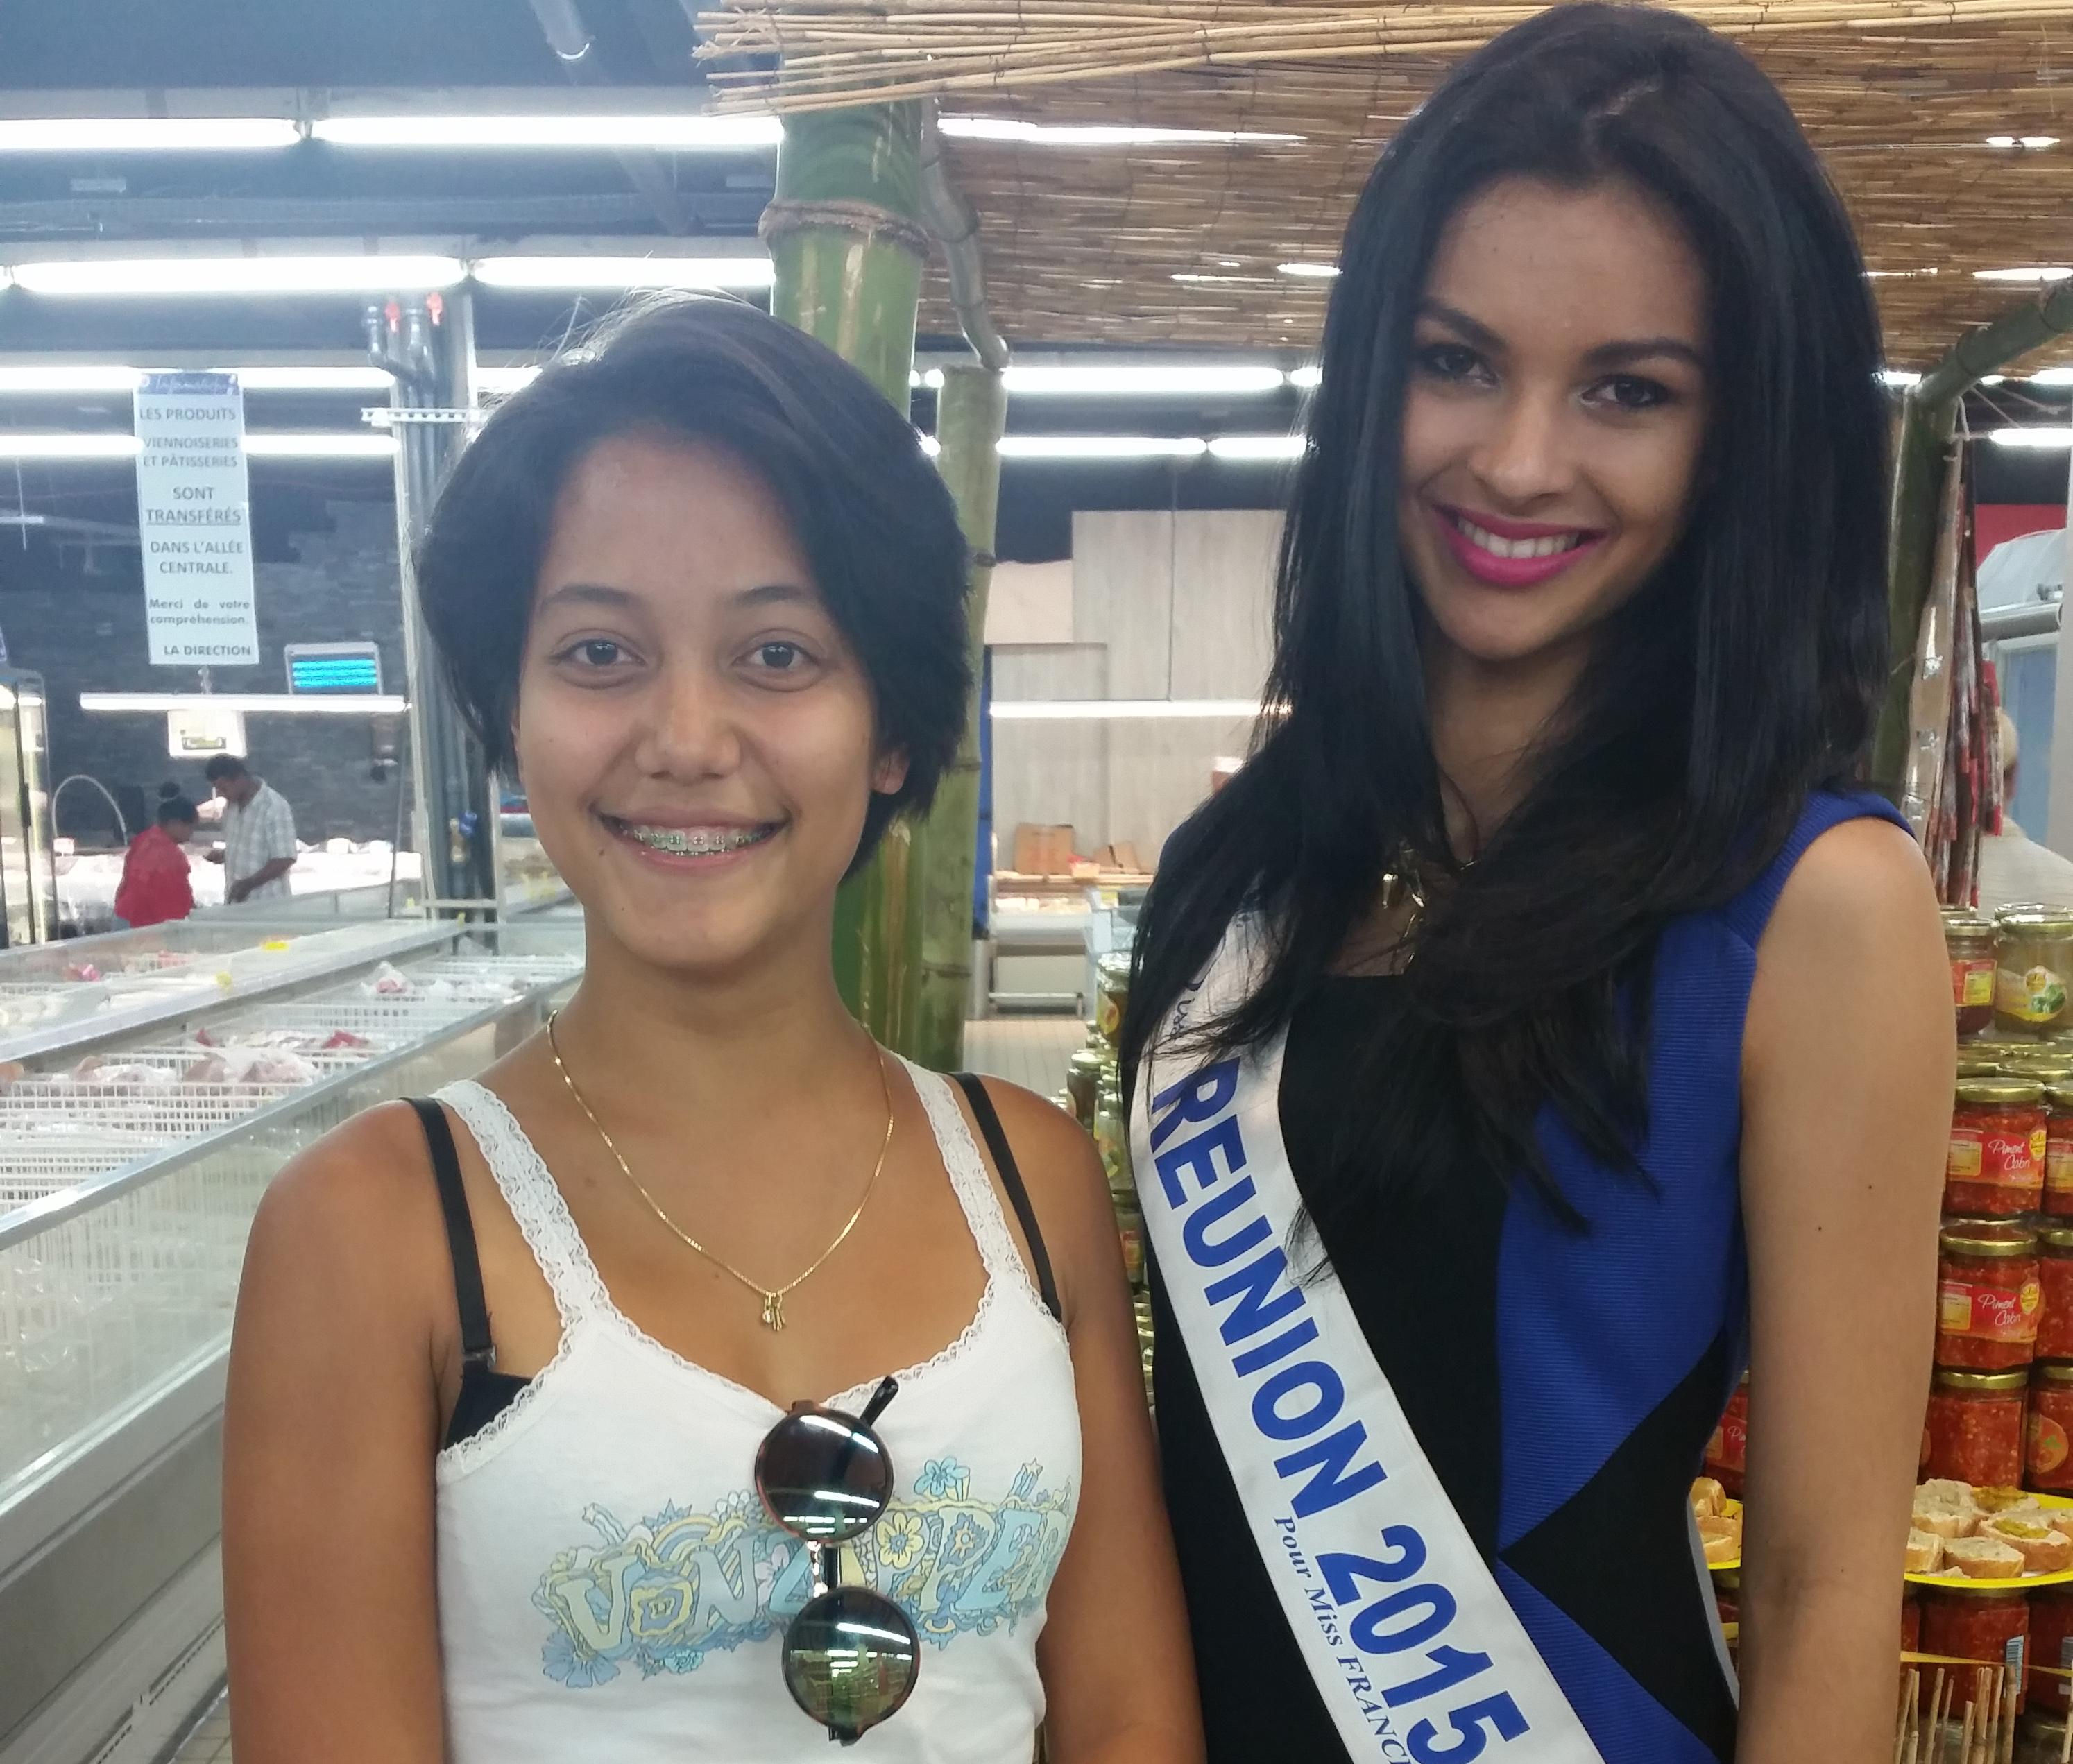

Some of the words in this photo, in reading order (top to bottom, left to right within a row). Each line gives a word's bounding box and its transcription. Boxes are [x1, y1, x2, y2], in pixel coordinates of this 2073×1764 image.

[139, 408, 162, 420] LES
[166, 408, 237, 421] PRODUITS
[144, 437, 239, 449] VIENNOISERIES
[144, 456, 157, 467] ET
[162, 453, 238, 468] PÂTISSERIES
[173, 487, 214, 500] SONT
[146, 506, 241, 522] TRANSFÉRÉS
[151, 541, 190, 554] DANS
[194, 539, 244, 554] L'ALLÉE
[160, 561, 233, 574] CENTRALE.
[149, 599, 183, 609] Merci
[194, 599, 209, 609] de
[219, 601, 250, 609] votre
[164, 646, 180, 656] LA
[184, 646, 250, 656] DIRECTION
[1150, 1057, 1388, 1519] REUNION
[1315, 1525, 1530, 1764] 2015
[1274, 1516, 1312, 1579] Pour
[1304, 1586, 1344, 1647] Miss
